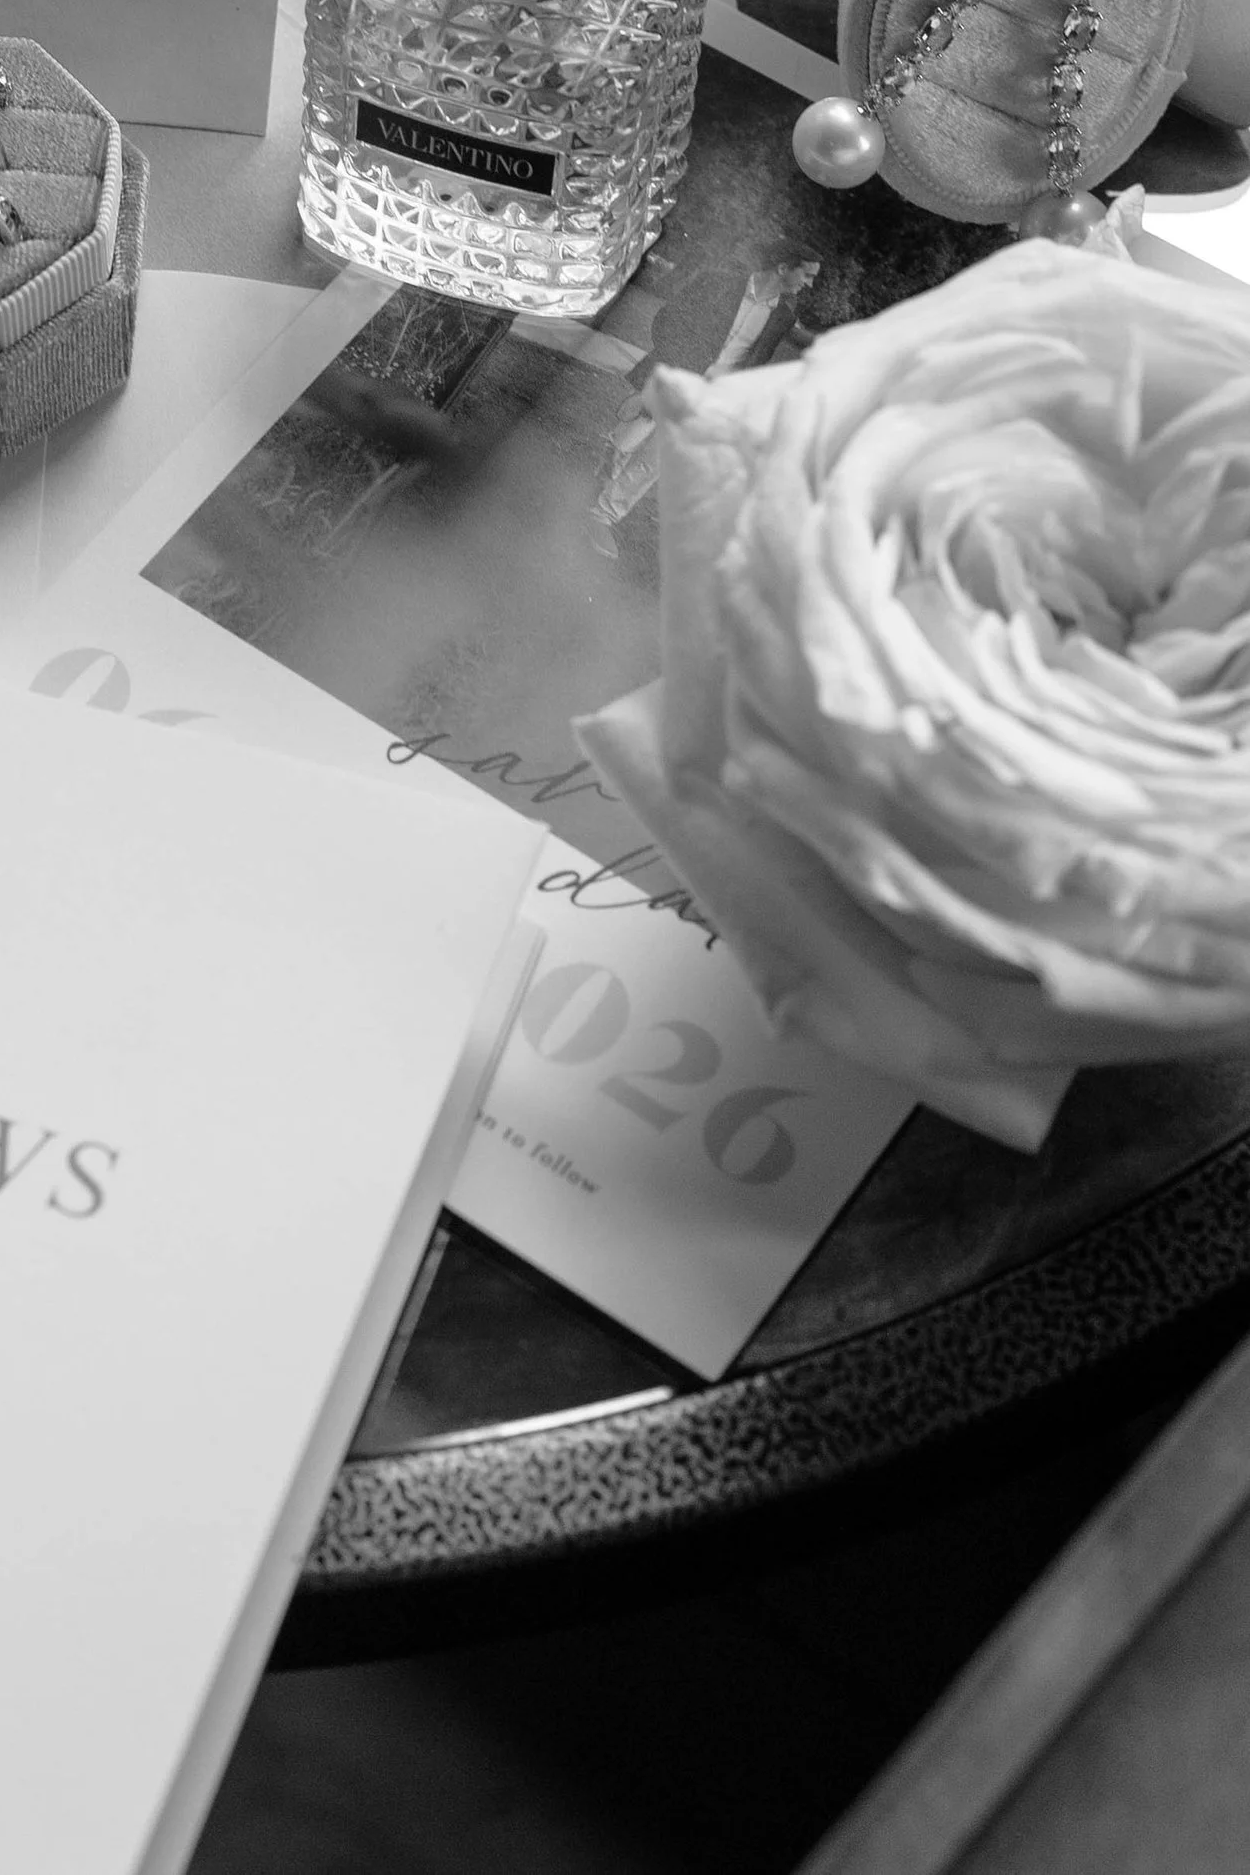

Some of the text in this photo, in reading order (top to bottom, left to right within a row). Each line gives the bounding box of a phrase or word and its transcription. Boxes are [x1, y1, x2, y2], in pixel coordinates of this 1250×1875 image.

[377, 117, 534, 180] VALENTINO
[386, 732, 622, 804] sav
[521, 961, 816, 1186] 026
[502, 1125, 601, 1194] to follow
